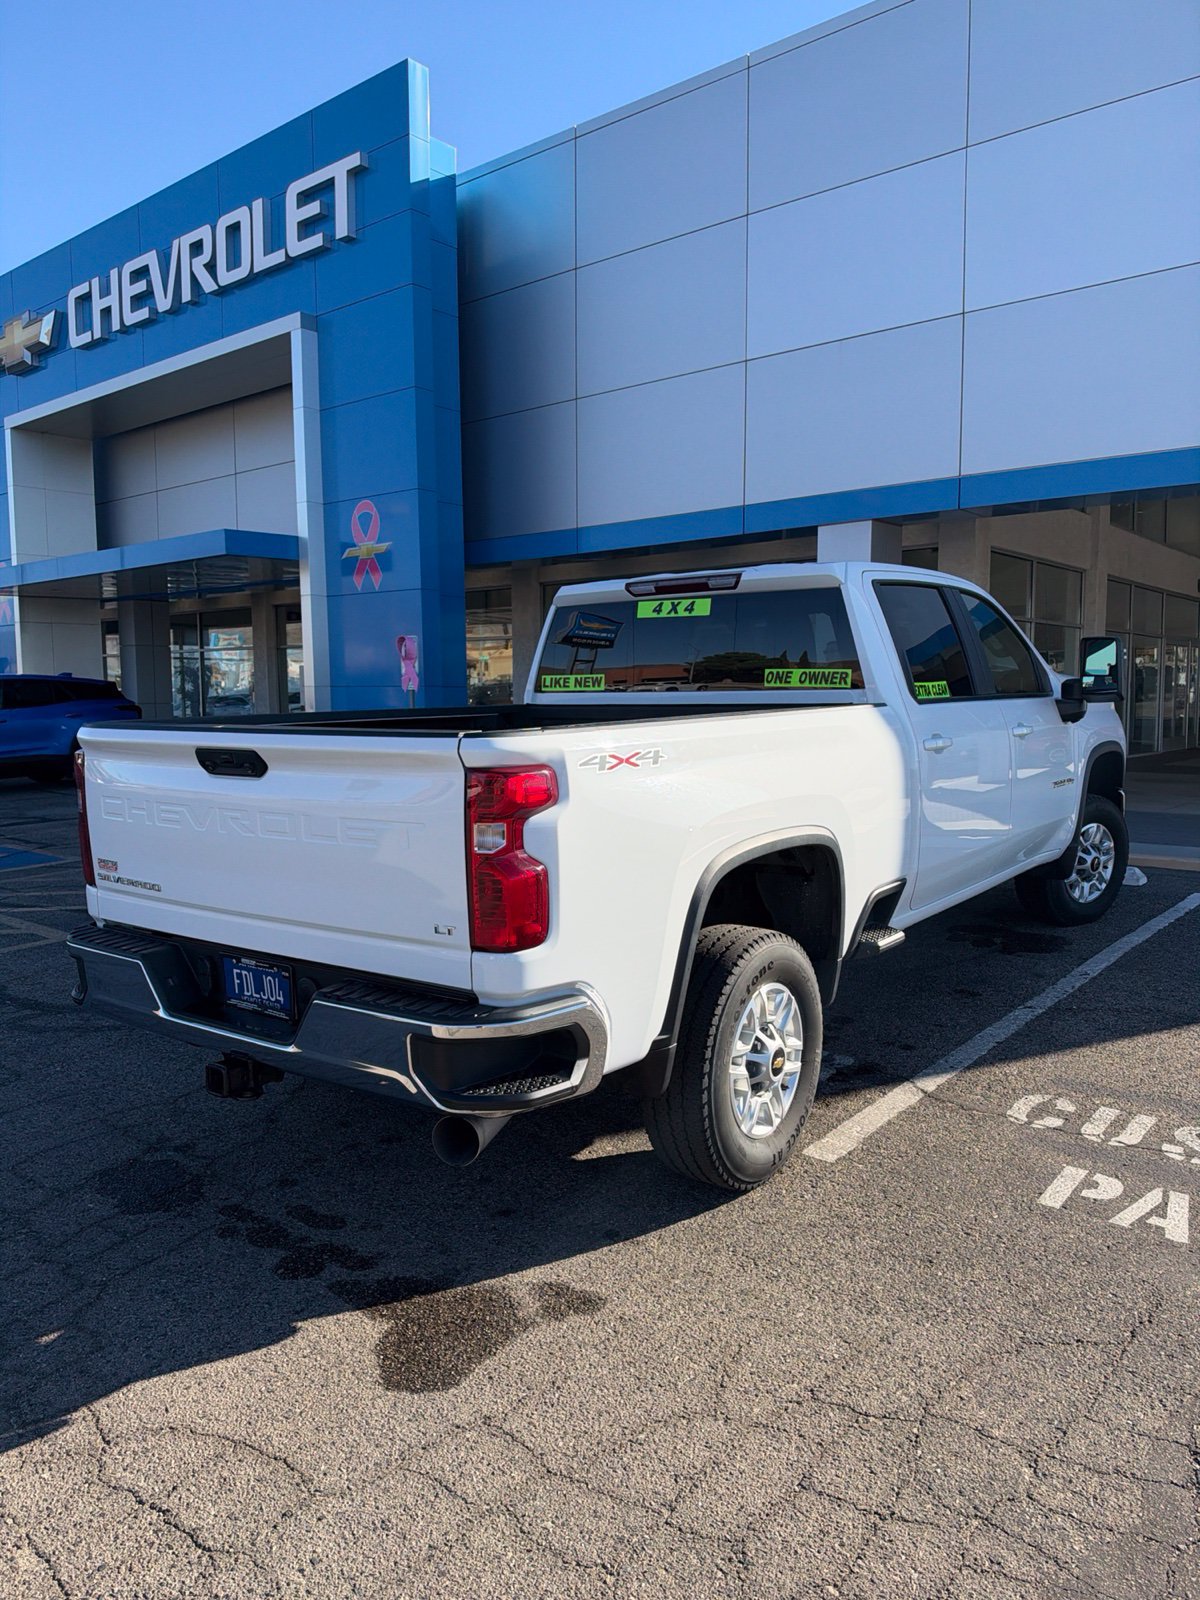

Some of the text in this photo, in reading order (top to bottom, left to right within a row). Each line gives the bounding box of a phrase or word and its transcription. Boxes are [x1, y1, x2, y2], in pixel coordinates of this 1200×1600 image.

[67, 151, 365, 349] CHEVROLET
[542, 676, 603, 689] LIKE NEW
[765, 670, 849, 686] ONE OWNER
[99, 793, 426, 849] CHEVROLET
[433, 923, 457, 936] LT
[1037, 1165, 1190, 1244] PA
